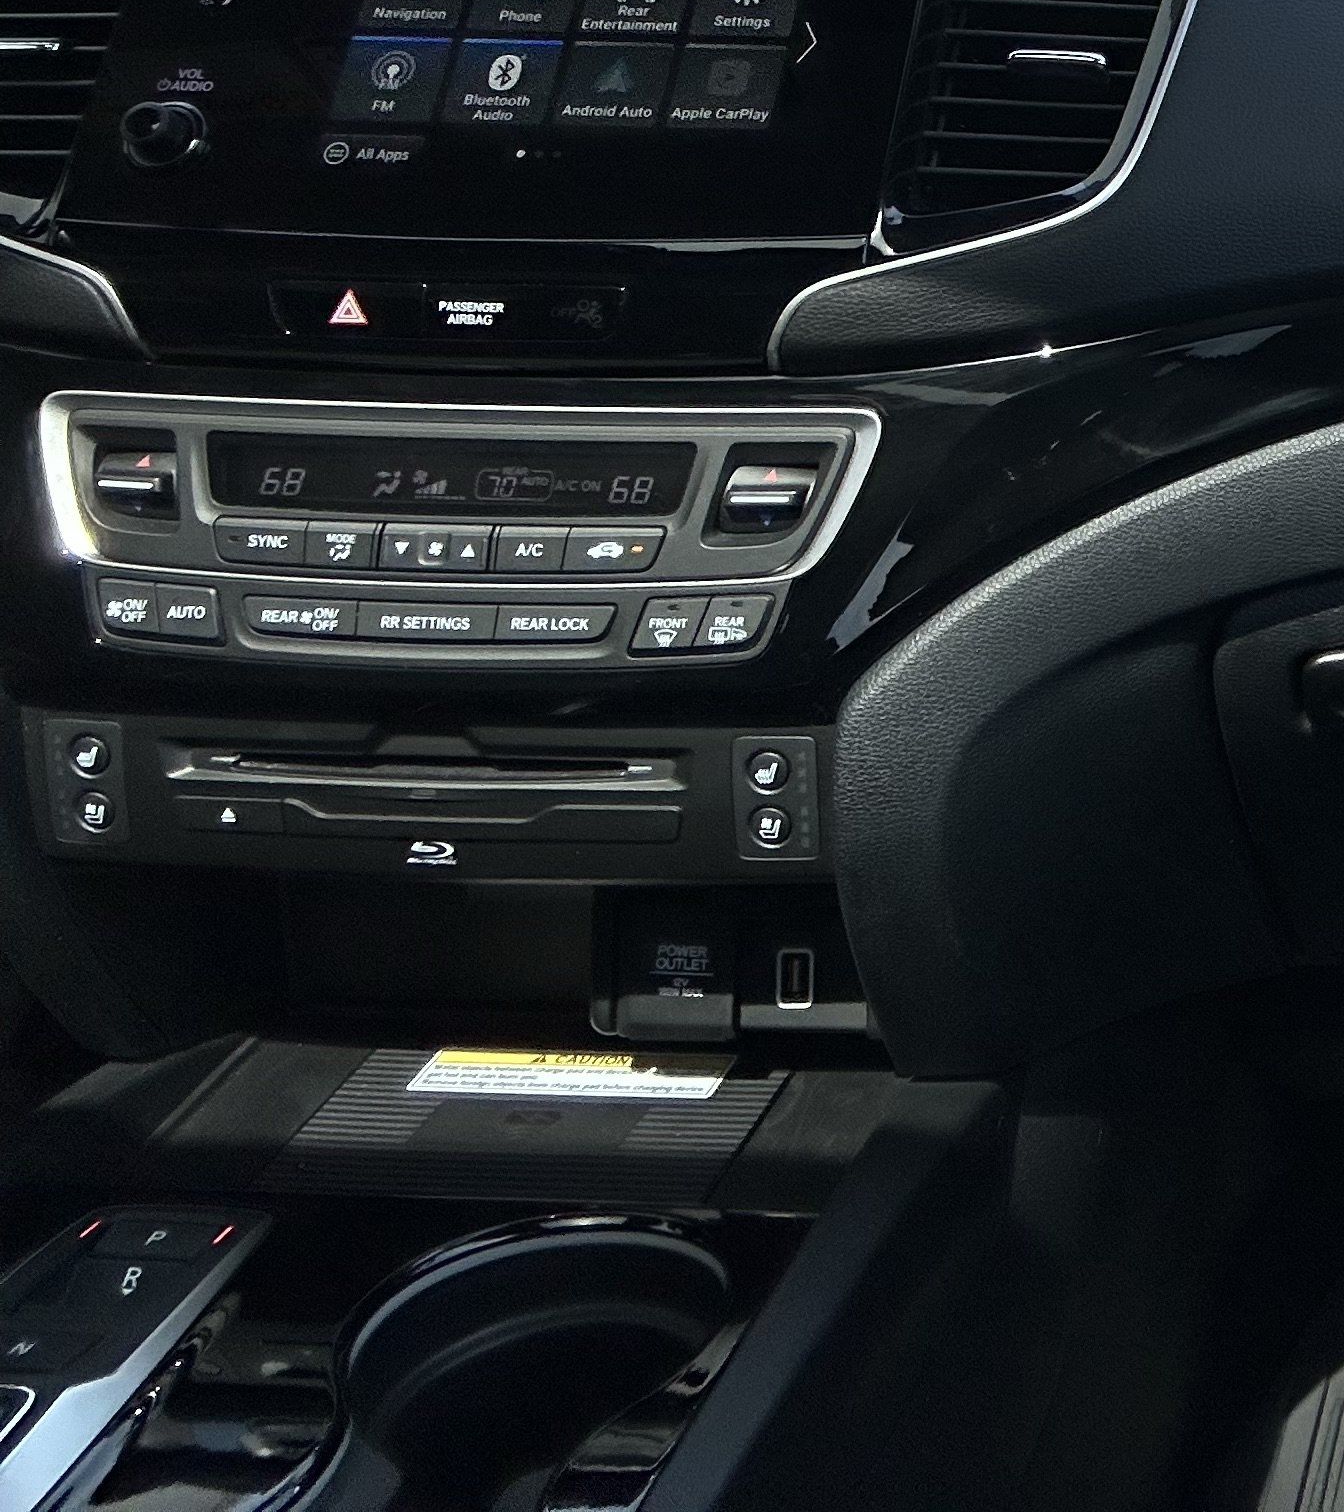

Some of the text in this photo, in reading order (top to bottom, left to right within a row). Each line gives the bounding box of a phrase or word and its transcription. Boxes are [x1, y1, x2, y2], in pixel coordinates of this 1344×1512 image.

[373, 7, 447, 21] Navigation
[499, 10, 542, 23] Phone
[618, 6, 650, 18] Rear
[581, 18, 678, 33] Entertainment
[714, 15, 771, 29] Settings
[178, 68, 205, 79] VOL
[170, 80, 214, 92] AUDIO
[371, 100, 396, 112] FM
[463, 94, 531, 107] Bluetooth
[472, 109, 514, 121] Audio
[561, 104, 653, 118] Android Auto
[670, 107, 769, 123] Apple CarPlay
[356, 149, 410, 163] All Apps
[438, 301, 505, 314] PASSENGER
[447, 314, 494, 326] AIRBAG
[259, 467, 306, 496] 68
[608, 476, 654, 504] 68
[247, 534, 289, 549] SYNC
[326, 534, 357, 543] MODE
[515, 543, 544, 557] A/C
[123, 598, 148, 611] ON/
[121, 610, 147, 623] OFF
[167, 606, 206, 620] AUTO
[261, 609, 299, 624] REAR
[311, 619, 338, 632] OFF
[380, 615, 471, 631] RR SETTINGS
[510, 617, 590, 631] REAR LOCK
[648, 617, 689, 629] FRONT
[714, 616, 744, 627] REAR
[657, 945, 709, 958] POWER
[655, 957, 709, 970] OUTLET
[555, 1055, 630, 1065] CAUTION
[144, 1230, 167, 1246] P
[121, 1266, 142, 1289] R
[7, 1341, 37, 1356] N
